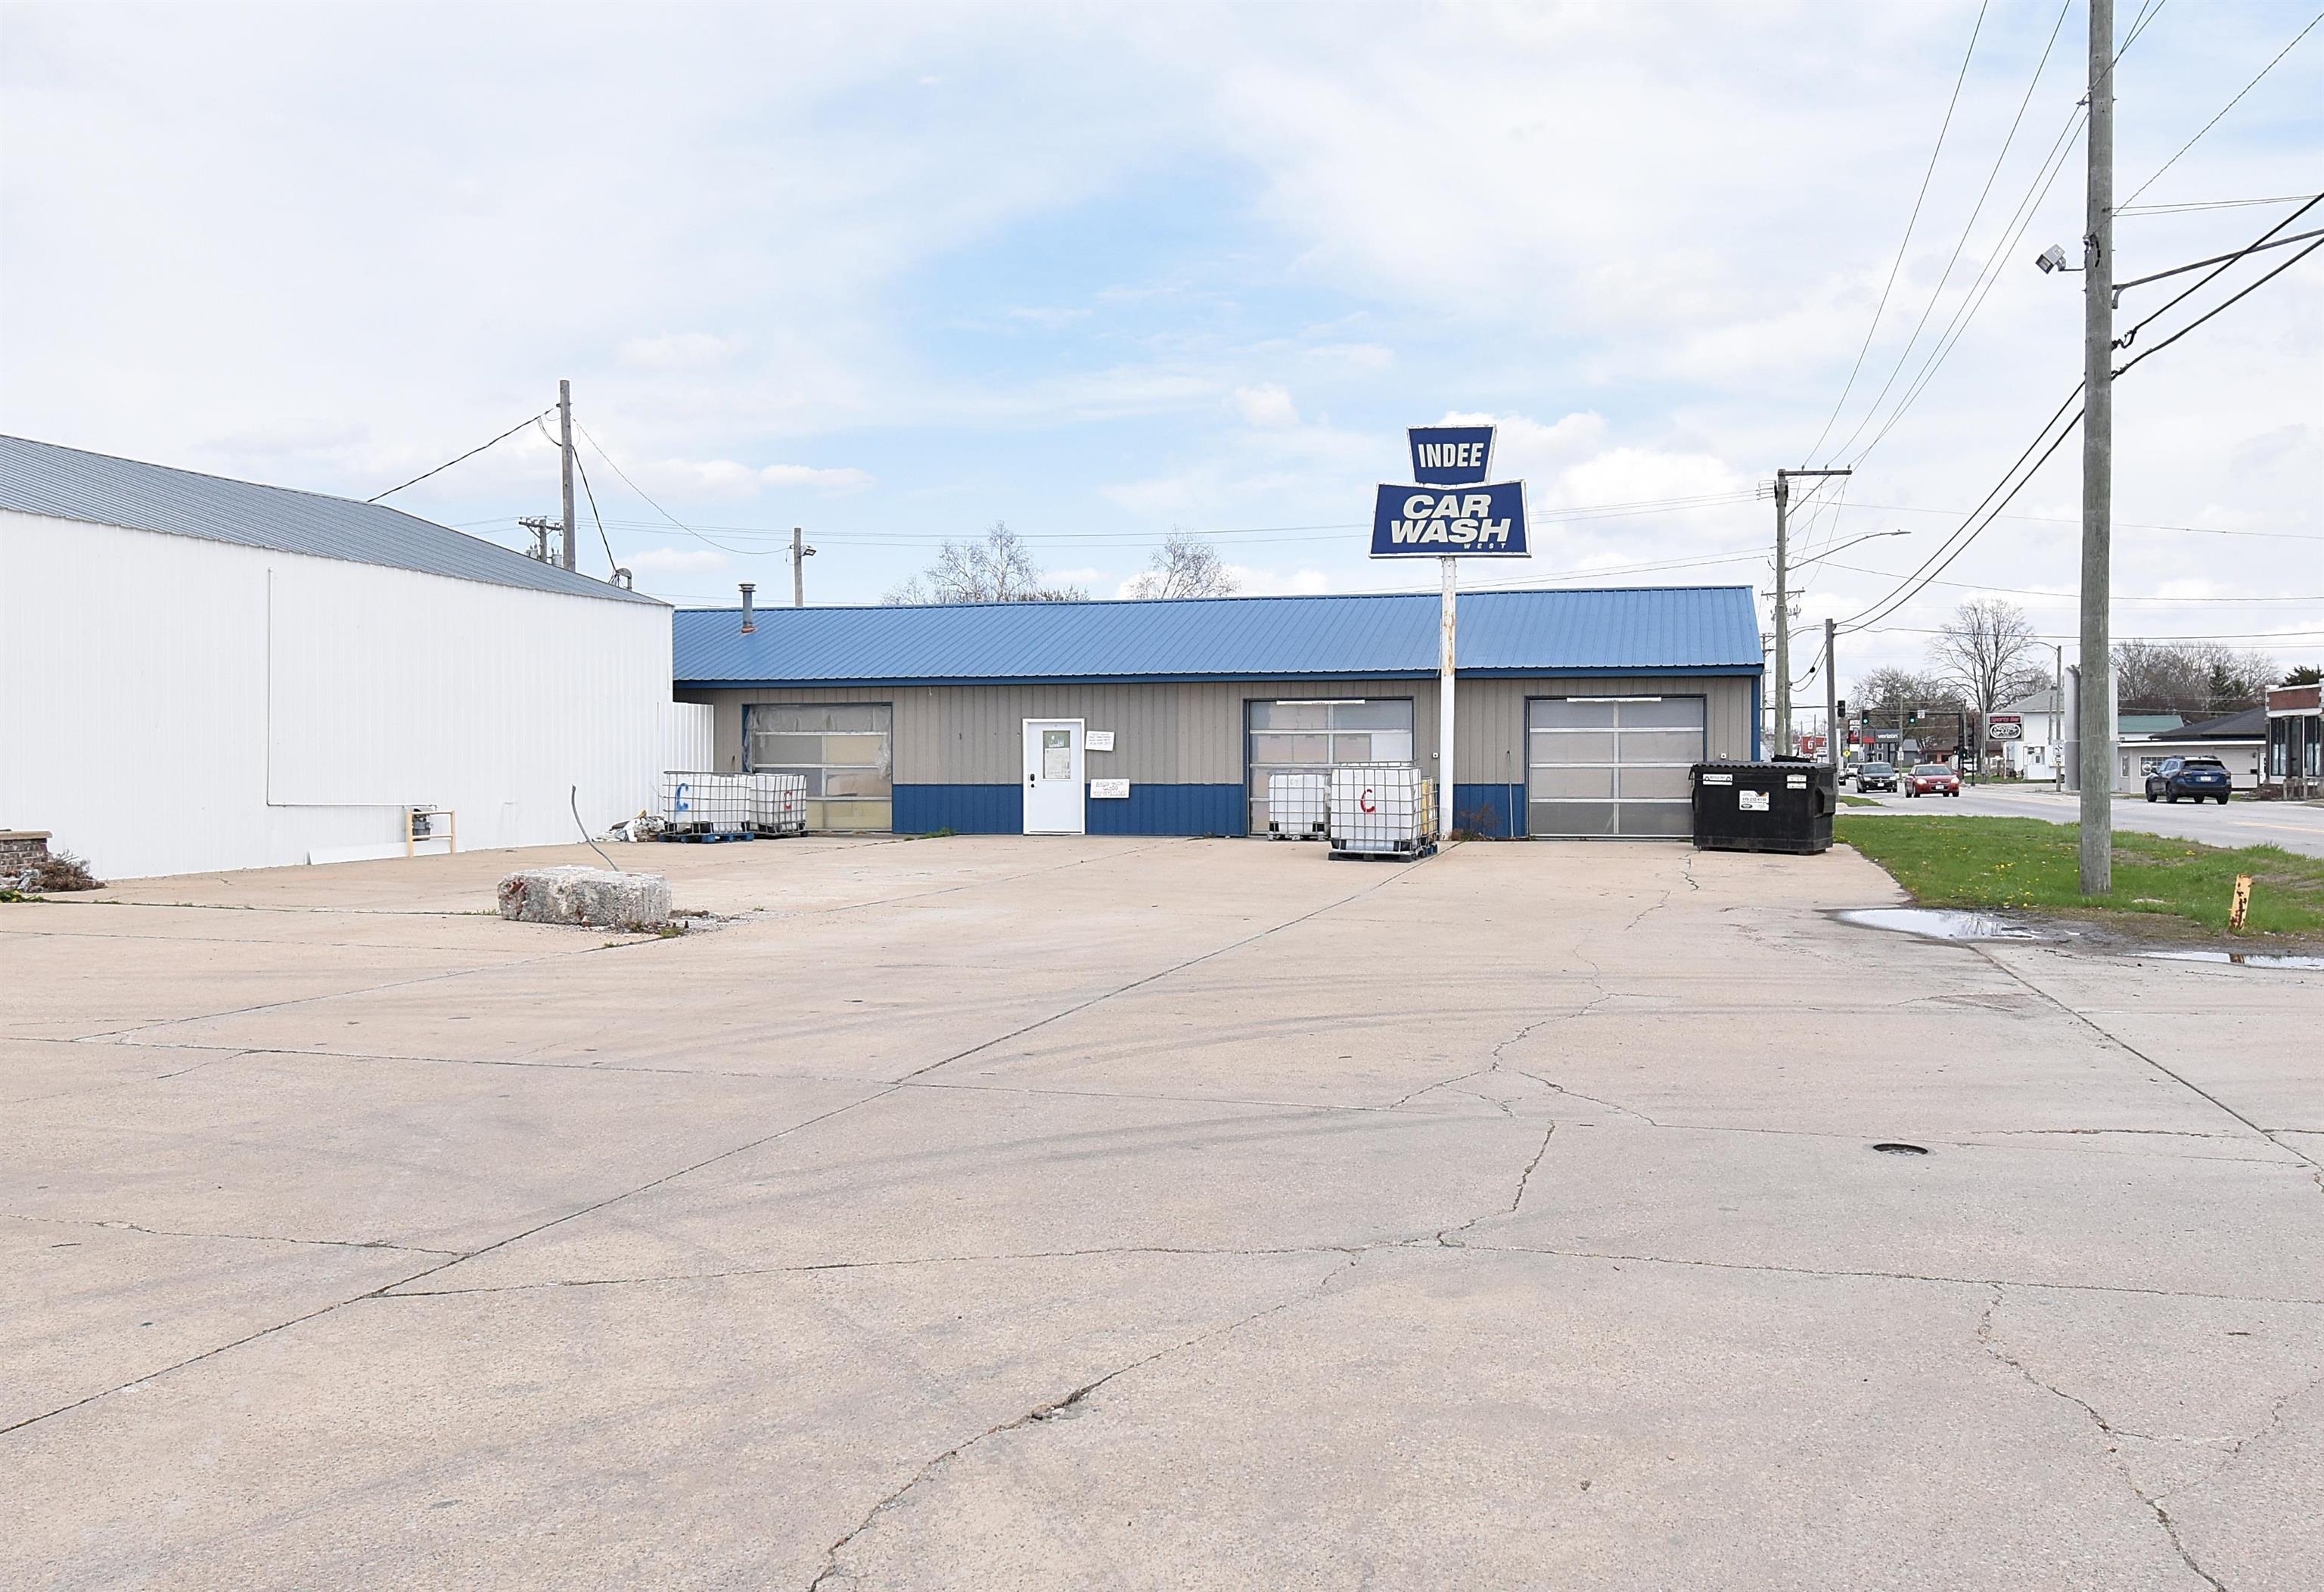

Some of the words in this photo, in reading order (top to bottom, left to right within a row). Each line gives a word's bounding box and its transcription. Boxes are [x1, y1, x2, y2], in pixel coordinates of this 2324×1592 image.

[1418, 443, 1484, 468] INDEE
[1403, 494, 1492, 519] CAR
[1390, 518, 1512, 544] WASH
[1360, 788, 1376, 813] C
